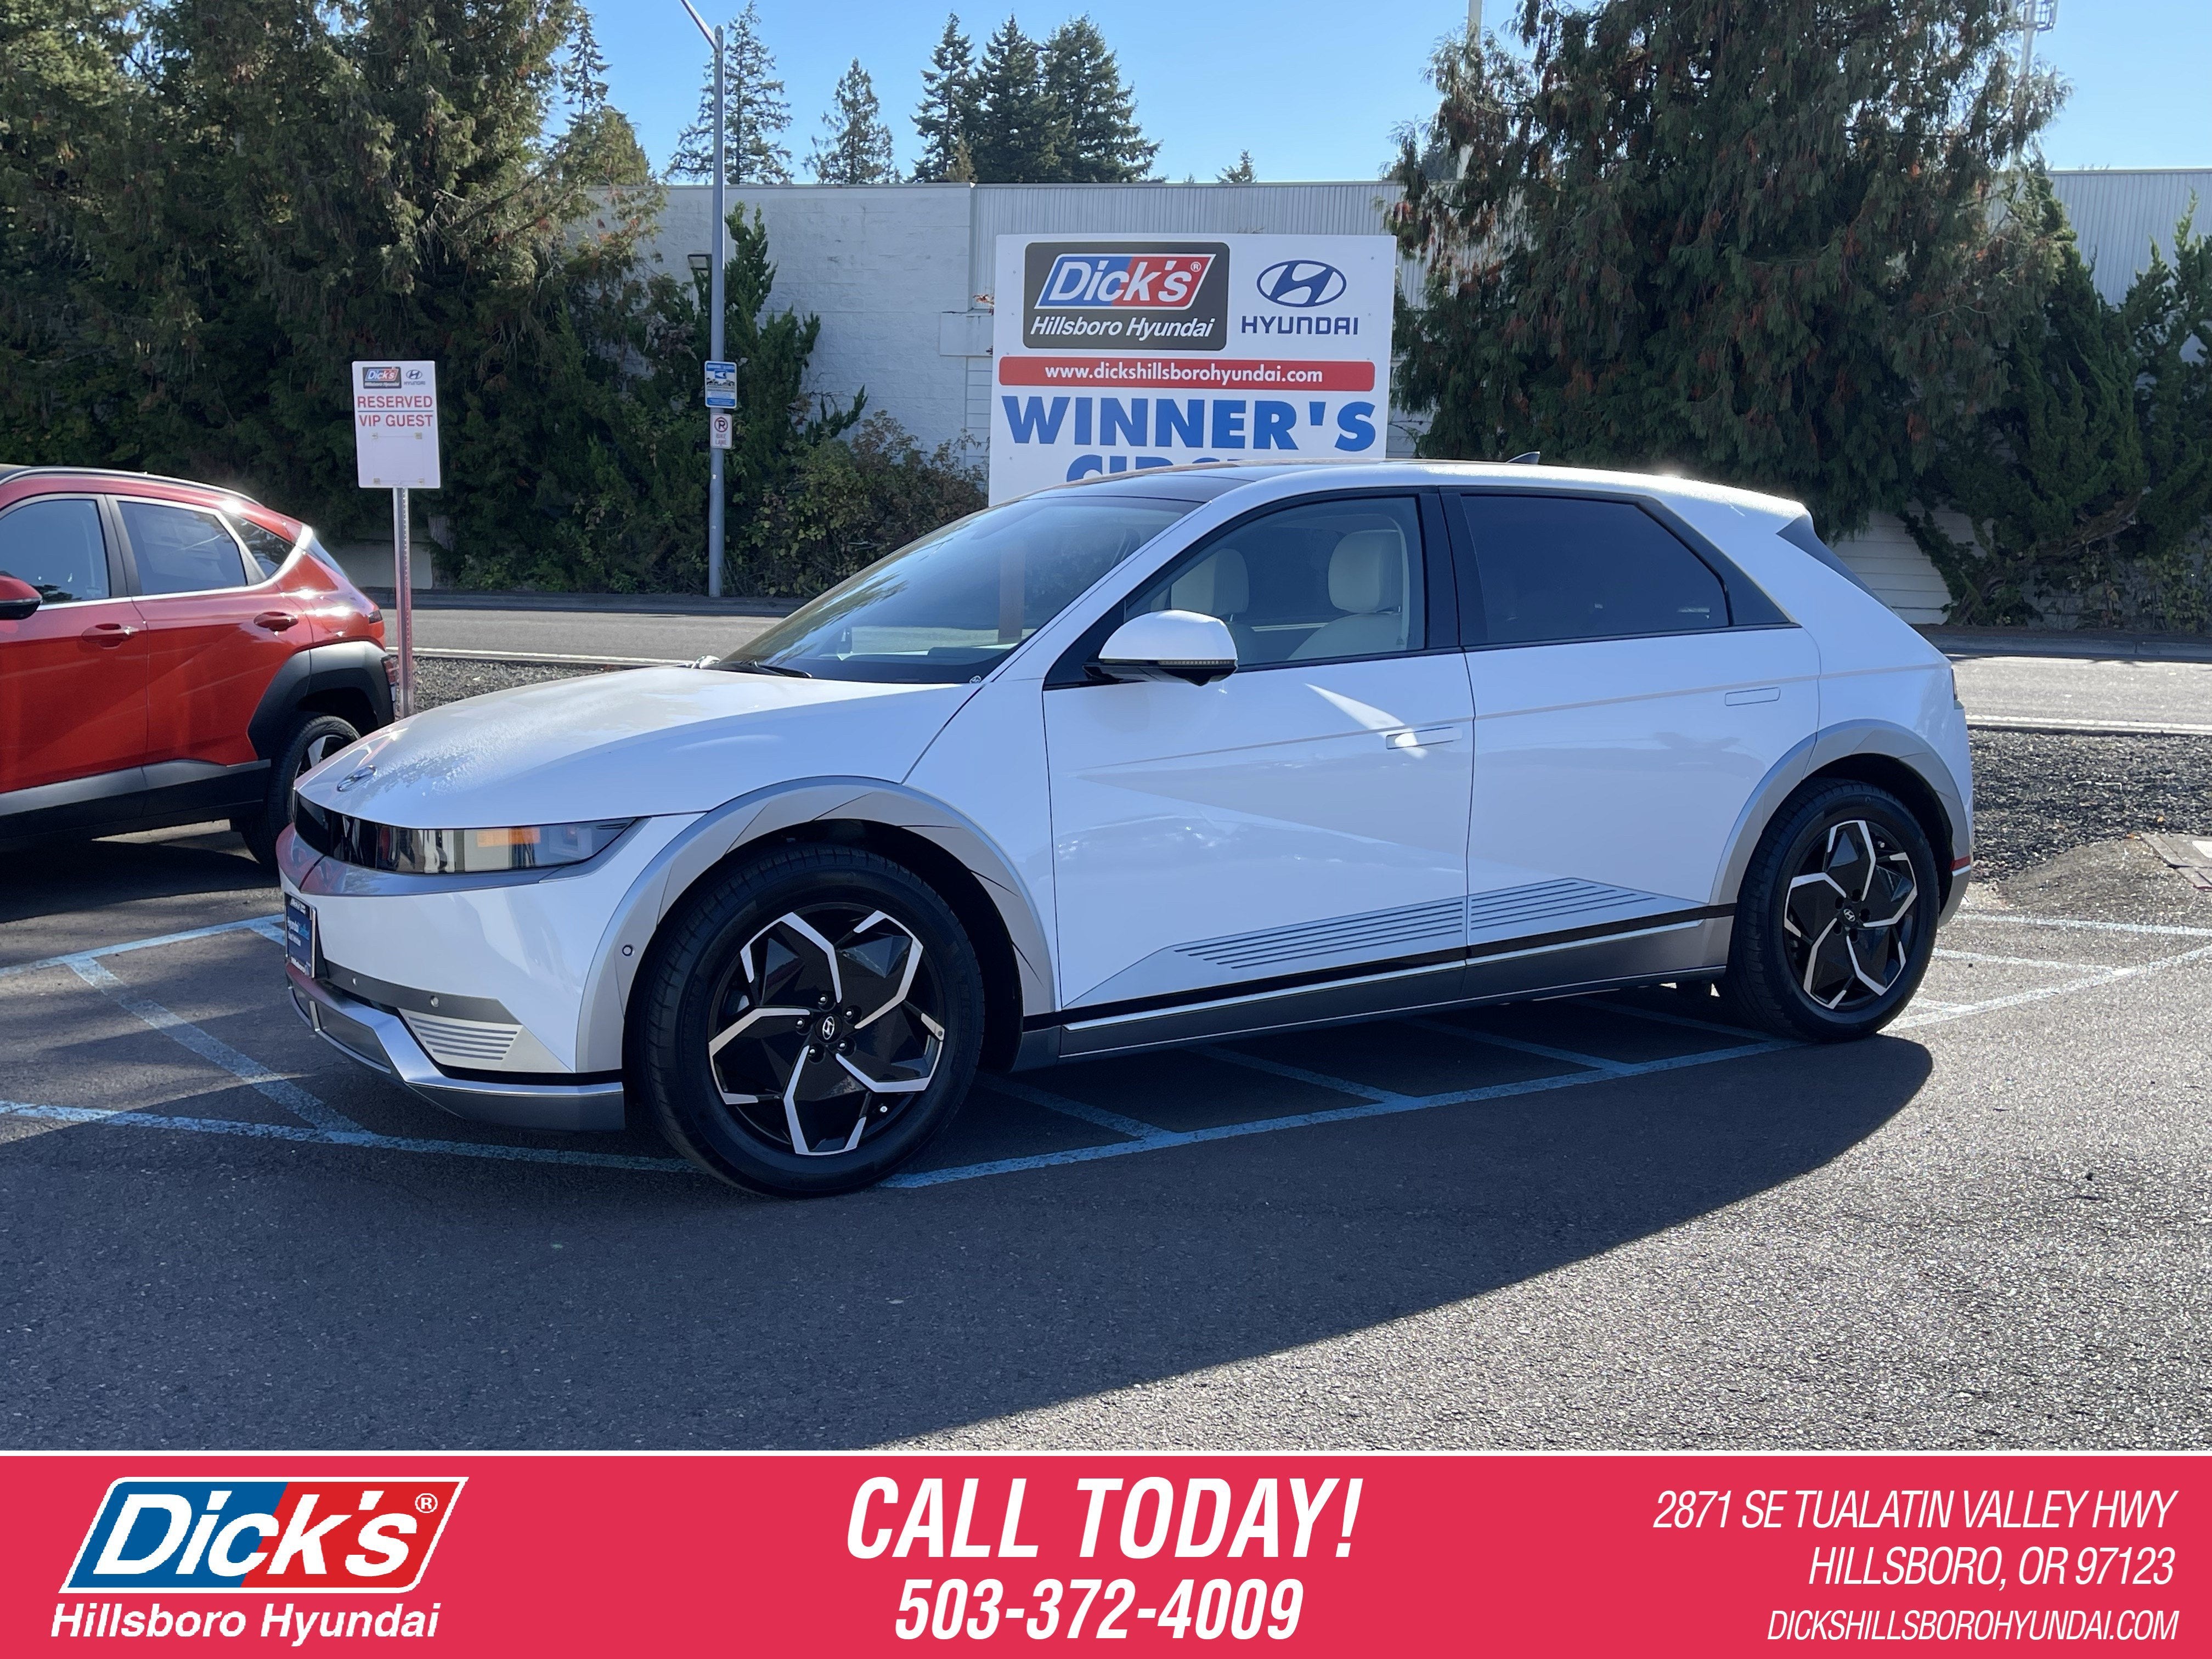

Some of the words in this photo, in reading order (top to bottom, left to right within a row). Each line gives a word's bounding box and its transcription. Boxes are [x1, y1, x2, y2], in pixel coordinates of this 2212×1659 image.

[1030, 316, 1122, 336] Hillsboro
[1126, 318, 1215, 341] Hyundai
[1242, 316, 1358, 335] HYUNDAI
[1045, 362, 1323, 386] www.dickshillsborohyundai.com
[357, 396, 433, 408] RESERVED
[359, 415, 381, 427] VIP
[385, 414, 433, 427] GUEST
[1002, 396, 1376, 452] WINNER'S
